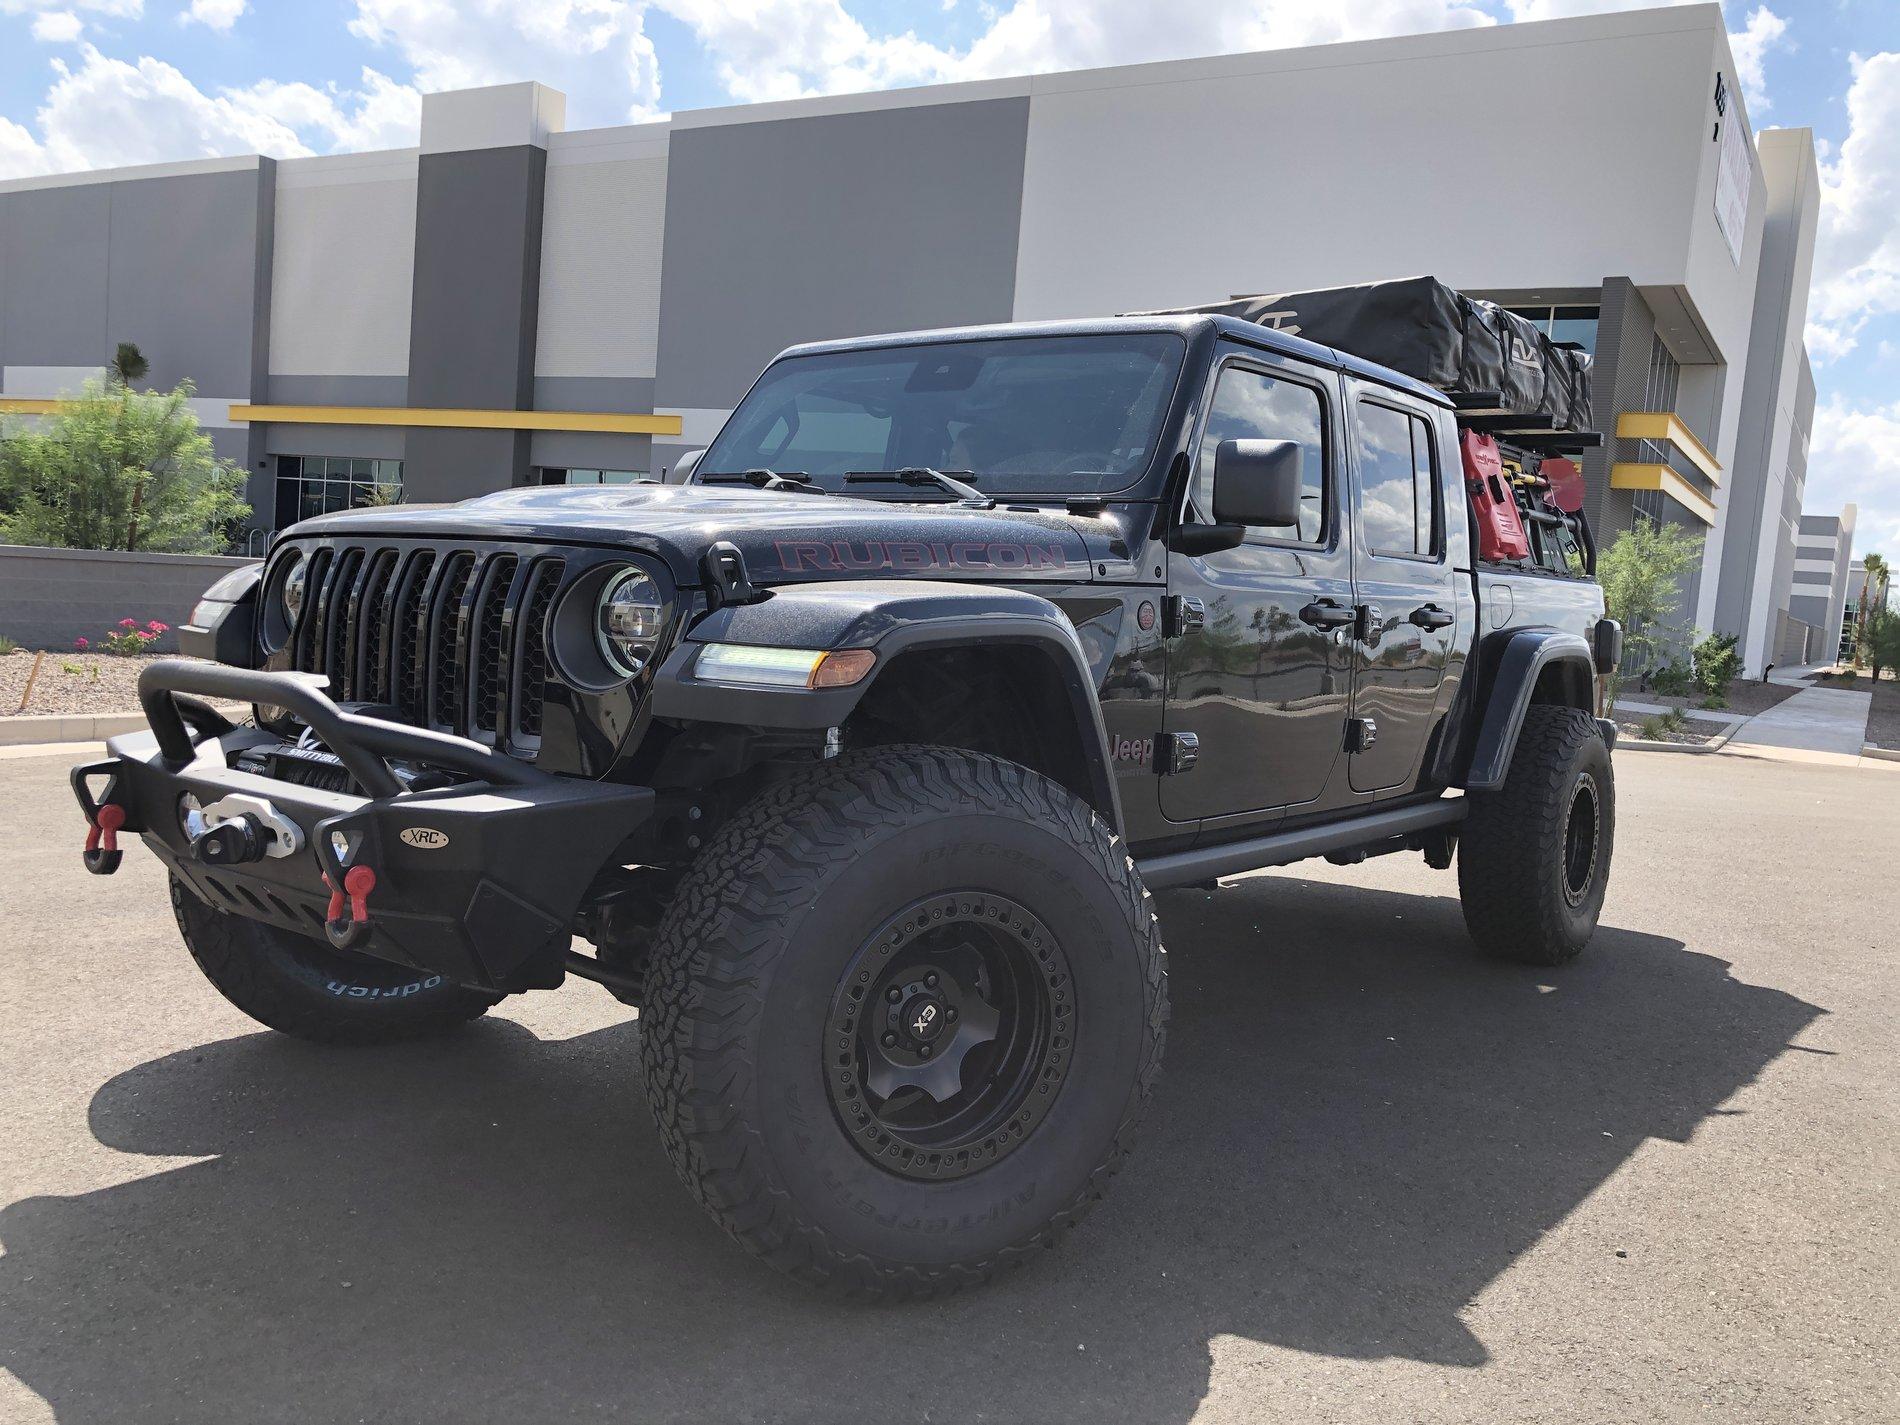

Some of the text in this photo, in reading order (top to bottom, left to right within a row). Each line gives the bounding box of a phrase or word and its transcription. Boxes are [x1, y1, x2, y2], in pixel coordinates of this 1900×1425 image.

[773, 541, 1067, 570] RUBICON
[1110, 734, 1153, 768] Jeep
[408, 829, 439, 844] XRC
[326, 975, 441, 1000] odrich
